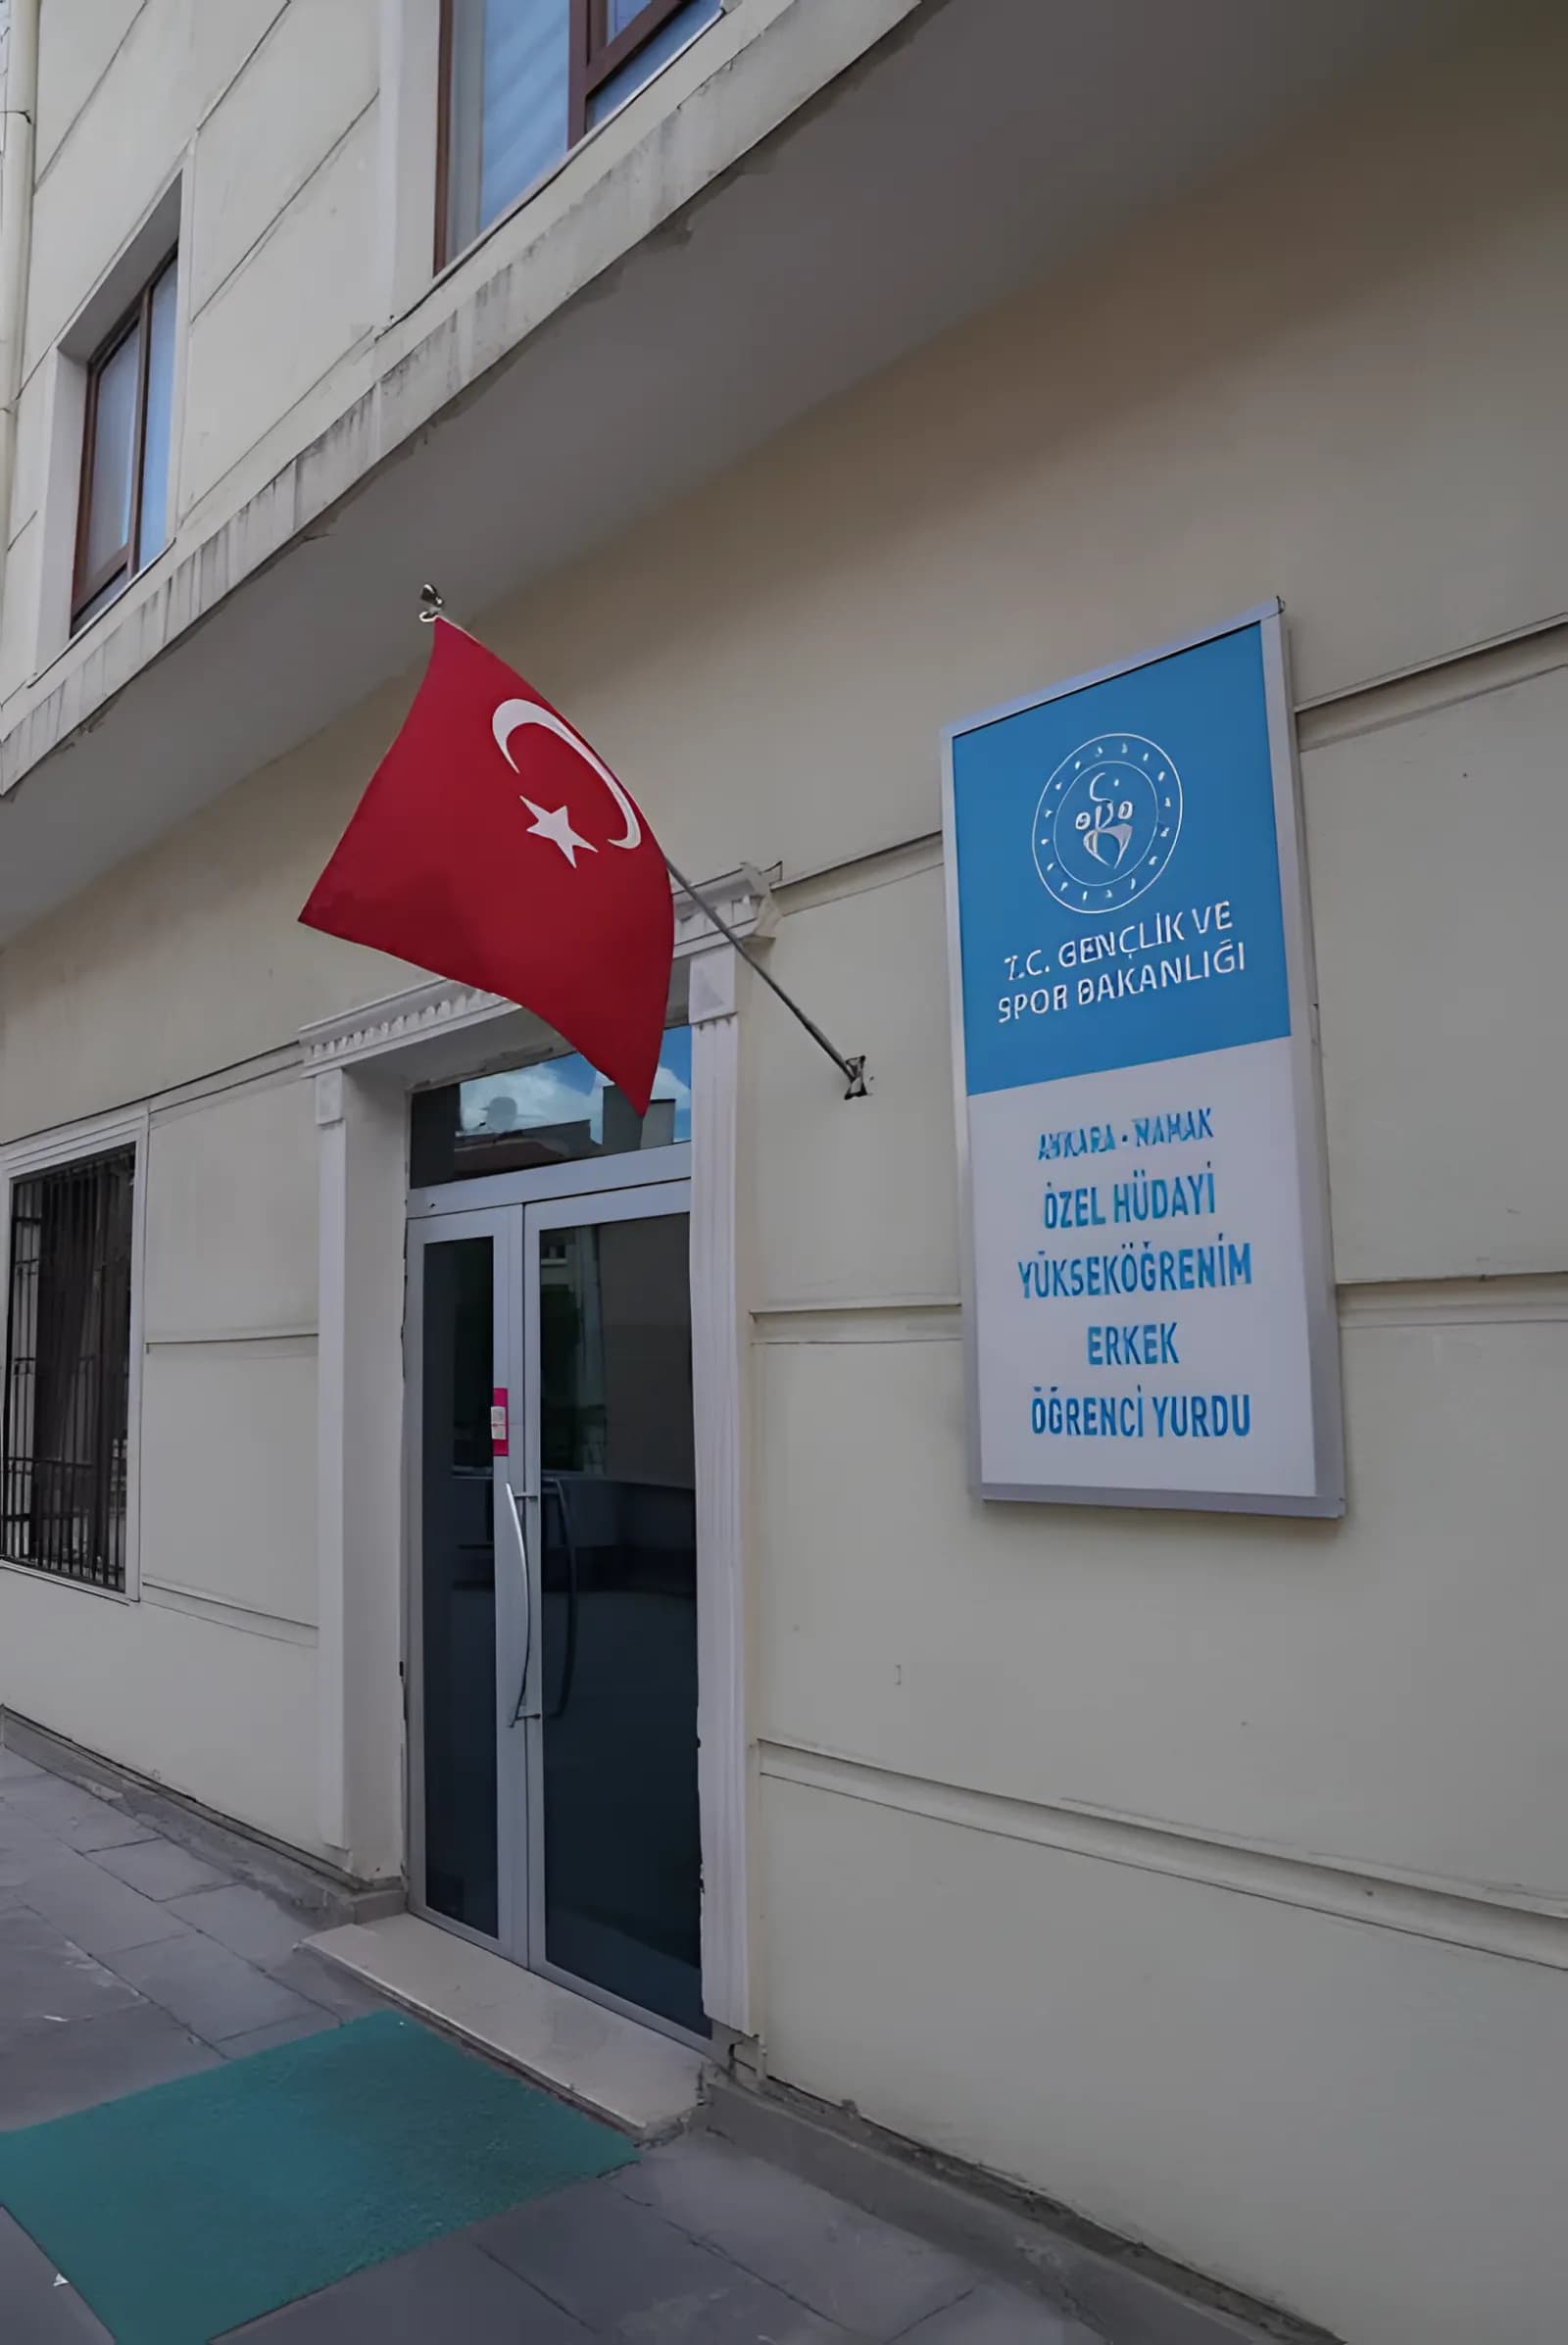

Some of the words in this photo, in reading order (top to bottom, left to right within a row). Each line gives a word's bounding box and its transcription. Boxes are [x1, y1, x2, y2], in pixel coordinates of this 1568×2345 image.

[1057, 911, 1184, 967] GENÇLİK
[1191, 901, 1233, 934] VE
[1077, 938, 1246, 1005] BAKANLIĞI
[1044, 1182, 1105, 1229] ÖZEL
[1113, 1161, 1215, 1223] HÜDAYİ
[1018, 1233, 1251, 1298] YÜKSEKÖĞRENİM
[1088, 1323, 1180, 1365] ERKEK
[1032, 1384, 1144, 1438] ÖĞRENCİ
[1152, 1393, 1250, 1438] YURDU
